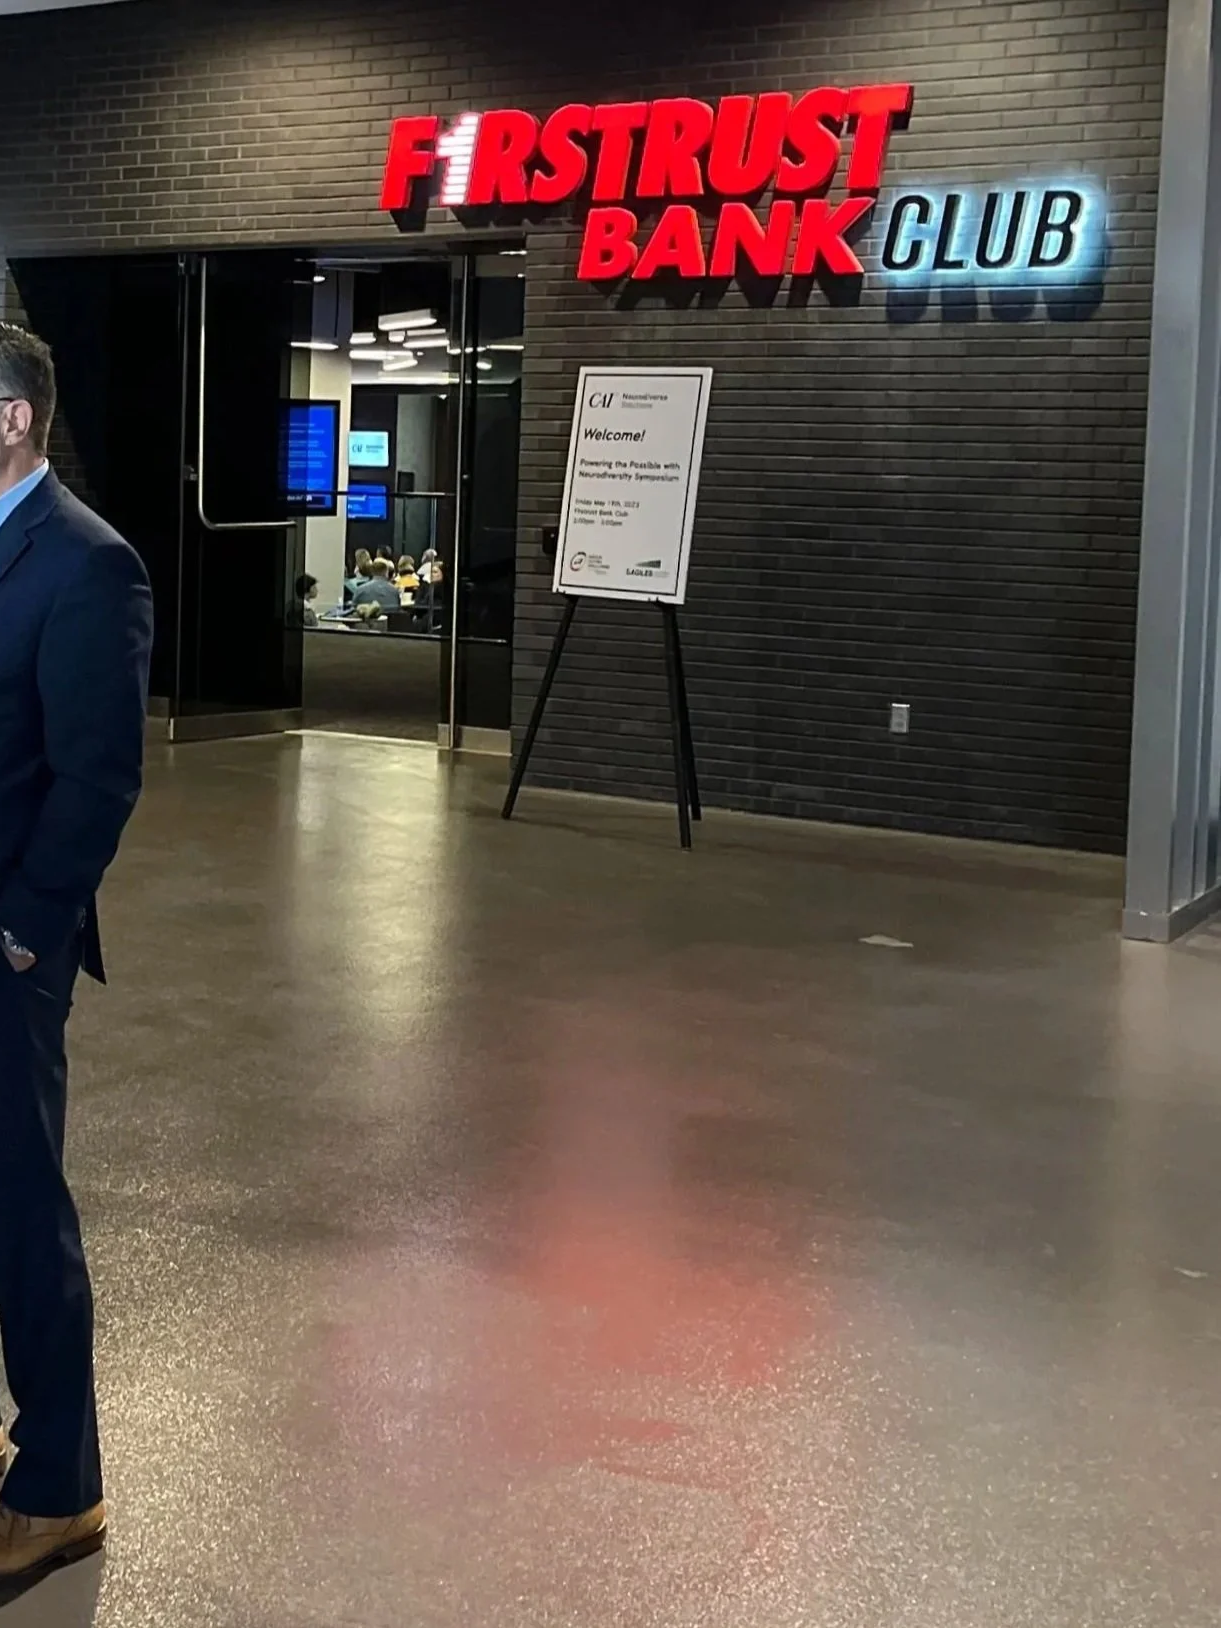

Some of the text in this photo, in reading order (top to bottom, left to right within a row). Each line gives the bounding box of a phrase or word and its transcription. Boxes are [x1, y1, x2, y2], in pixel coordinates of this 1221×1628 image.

[578, 190, 1084, 281] BANK CLUB
[584, 427, 646, 442] Welcome!
[580, 458, 680, 470] Powering the Possible with
[579, 470, 632, 482] Neurodiversity
